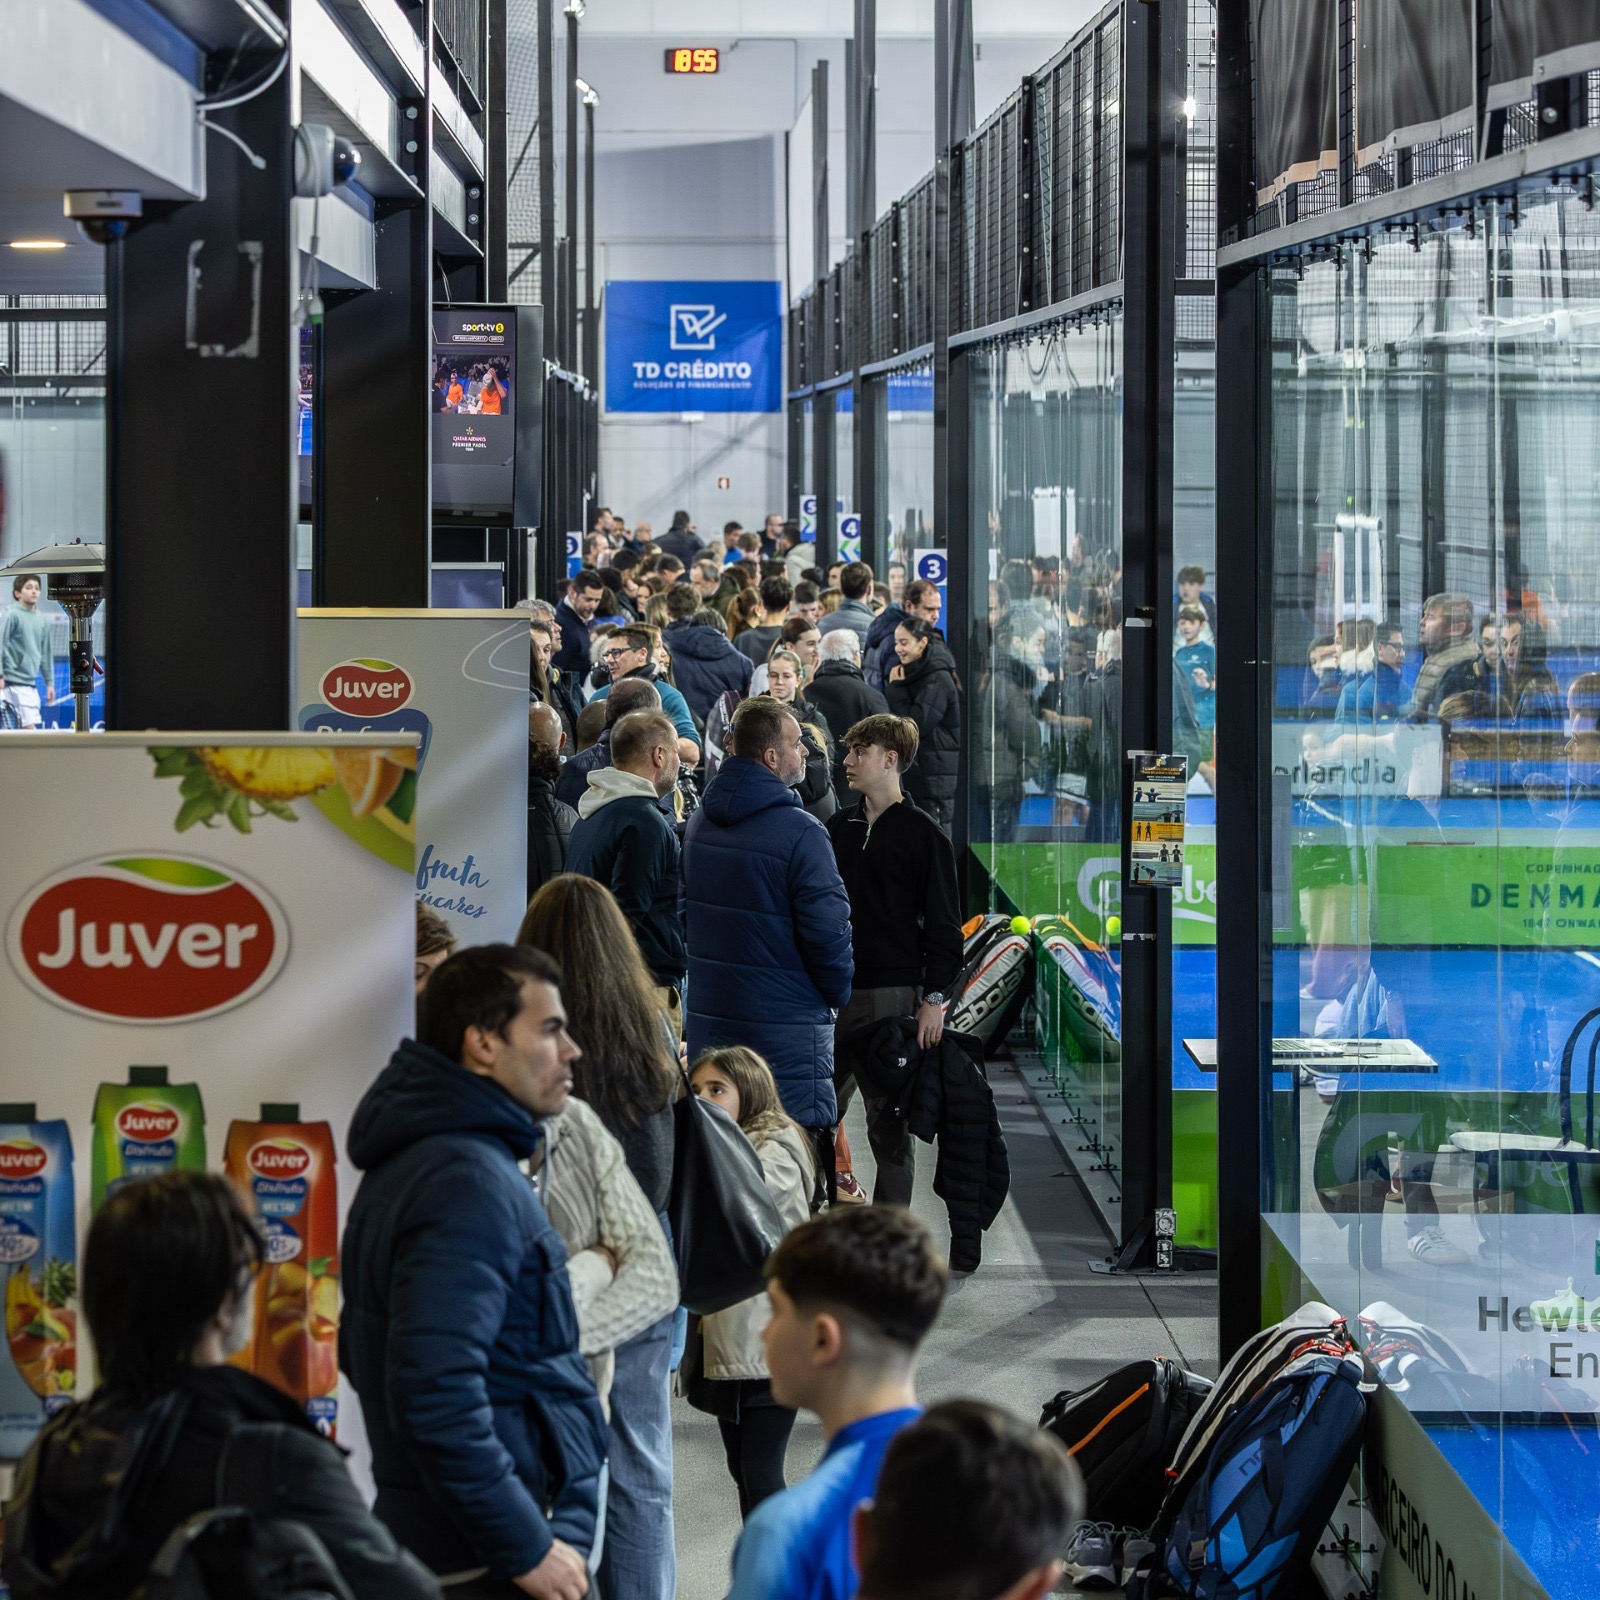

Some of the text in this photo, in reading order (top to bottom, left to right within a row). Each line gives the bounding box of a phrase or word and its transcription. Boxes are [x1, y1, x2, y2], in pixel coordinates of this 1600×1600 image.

[632, 358, 752, 379] TD CRÉDITO
[807, 502, 817, 513] 5
[845, 521, 858, 536] 4
[927, 559, 941, 580] 3
[328, 676, 406, 699] Juver
[415, 844, 490, 890] fruta
[37, 907, 259, 970] Juver
[122, 1113, 176, 1131] Juver
[0, 1152, 44, 1169] uver
[253, 1151, 308, 1169] Juver
